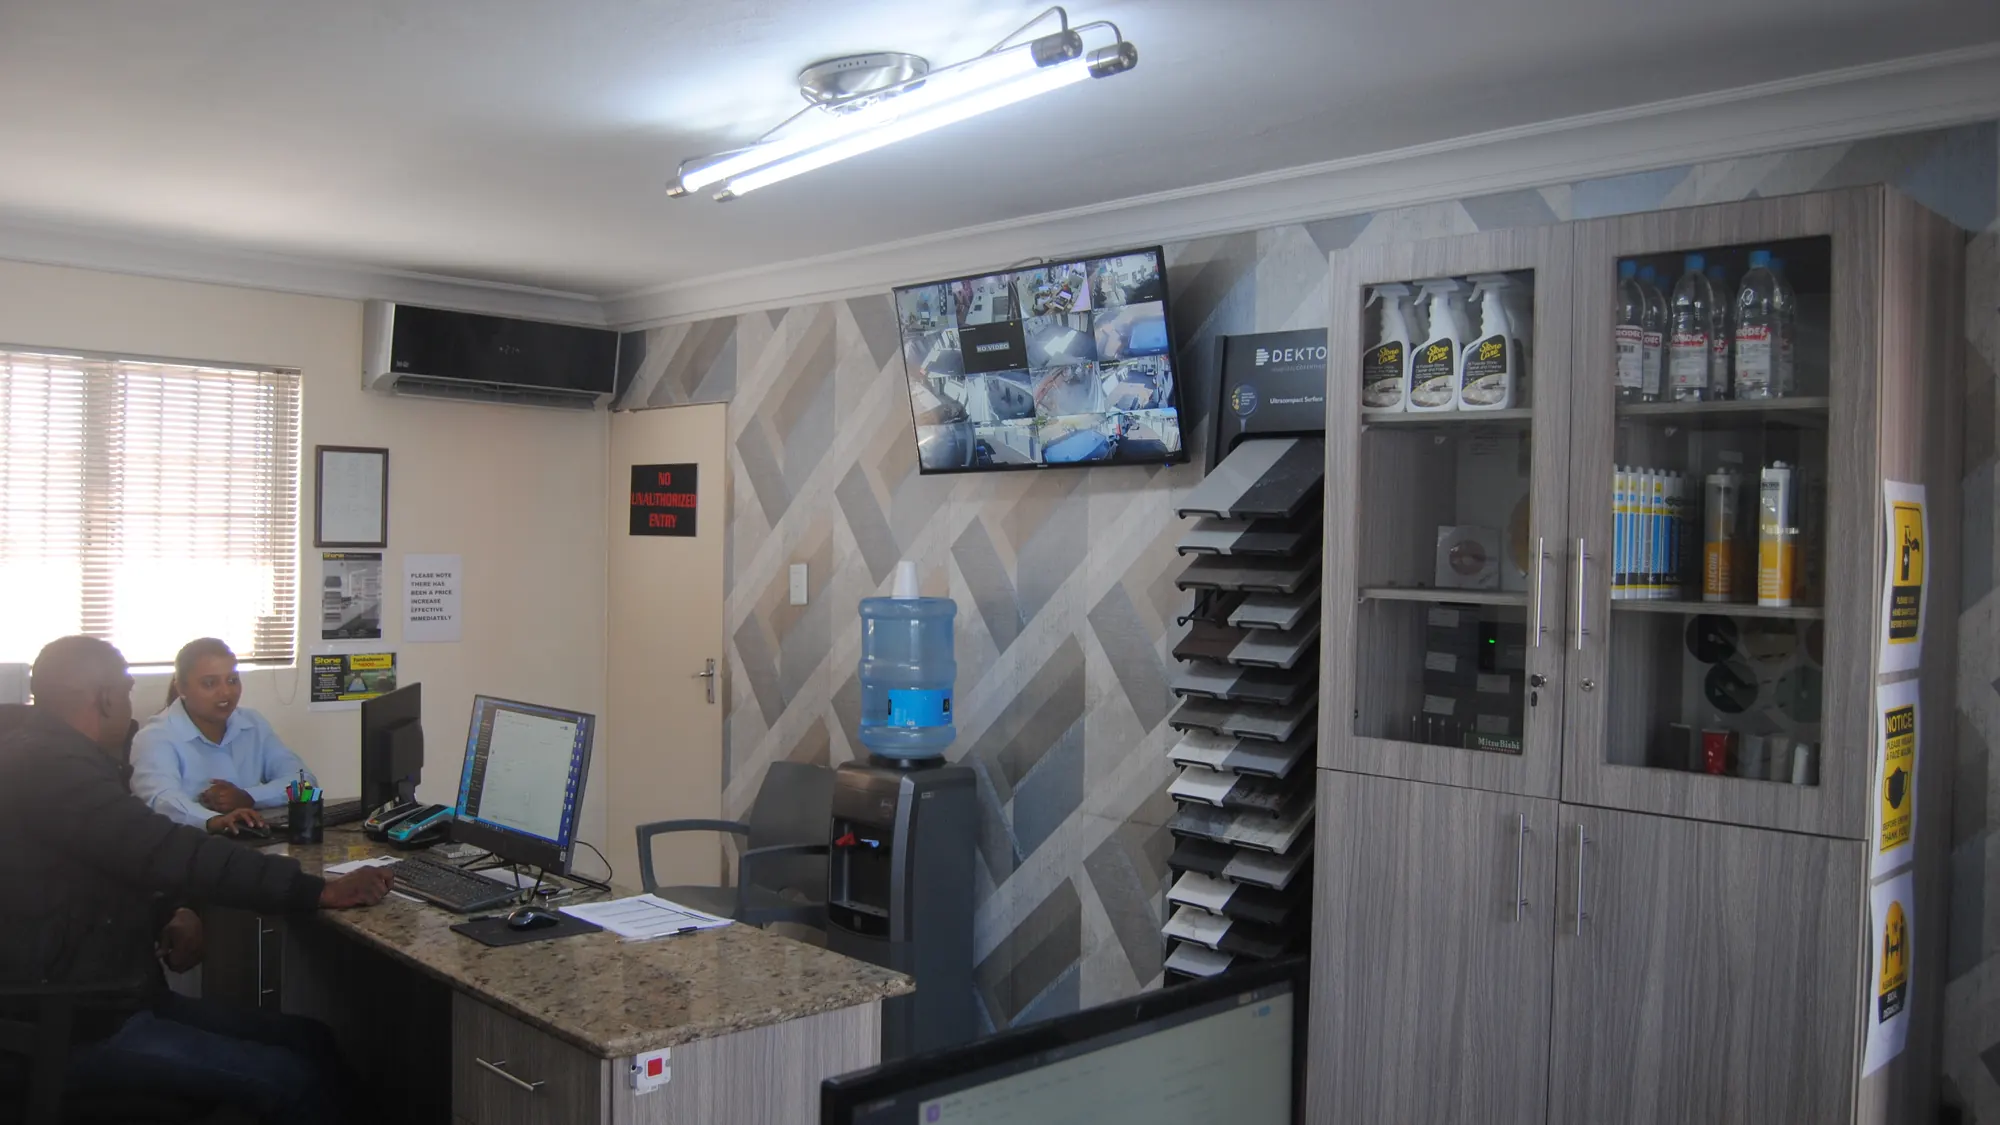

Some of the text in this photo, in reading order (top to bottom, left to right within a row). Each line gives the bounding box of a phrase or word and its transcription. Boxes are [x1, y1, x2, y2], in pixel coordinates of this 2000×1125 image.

[988, 341, 1009, 350] VIDEO
[1427, 345, 1449, 356] Stone
[1479, 341, 1502, 352] Stone
[1272, 346, 1327, 362] DEKTO
[1378, 346, 1400, 357] Stone
[1480, 349, 1500, 360] Care
[1378, 353, 1398, 365] Care
[1428, 352, 1447, 363] Care
[658, 472, 671, 486] NO
[631, 491, 696, 508] UNAUTHORIZED
[648, 513, 677, 528] ENTRY
[314, 656, 341, 665] Stone
[1886, 711, 1913, 734] NOTICE
